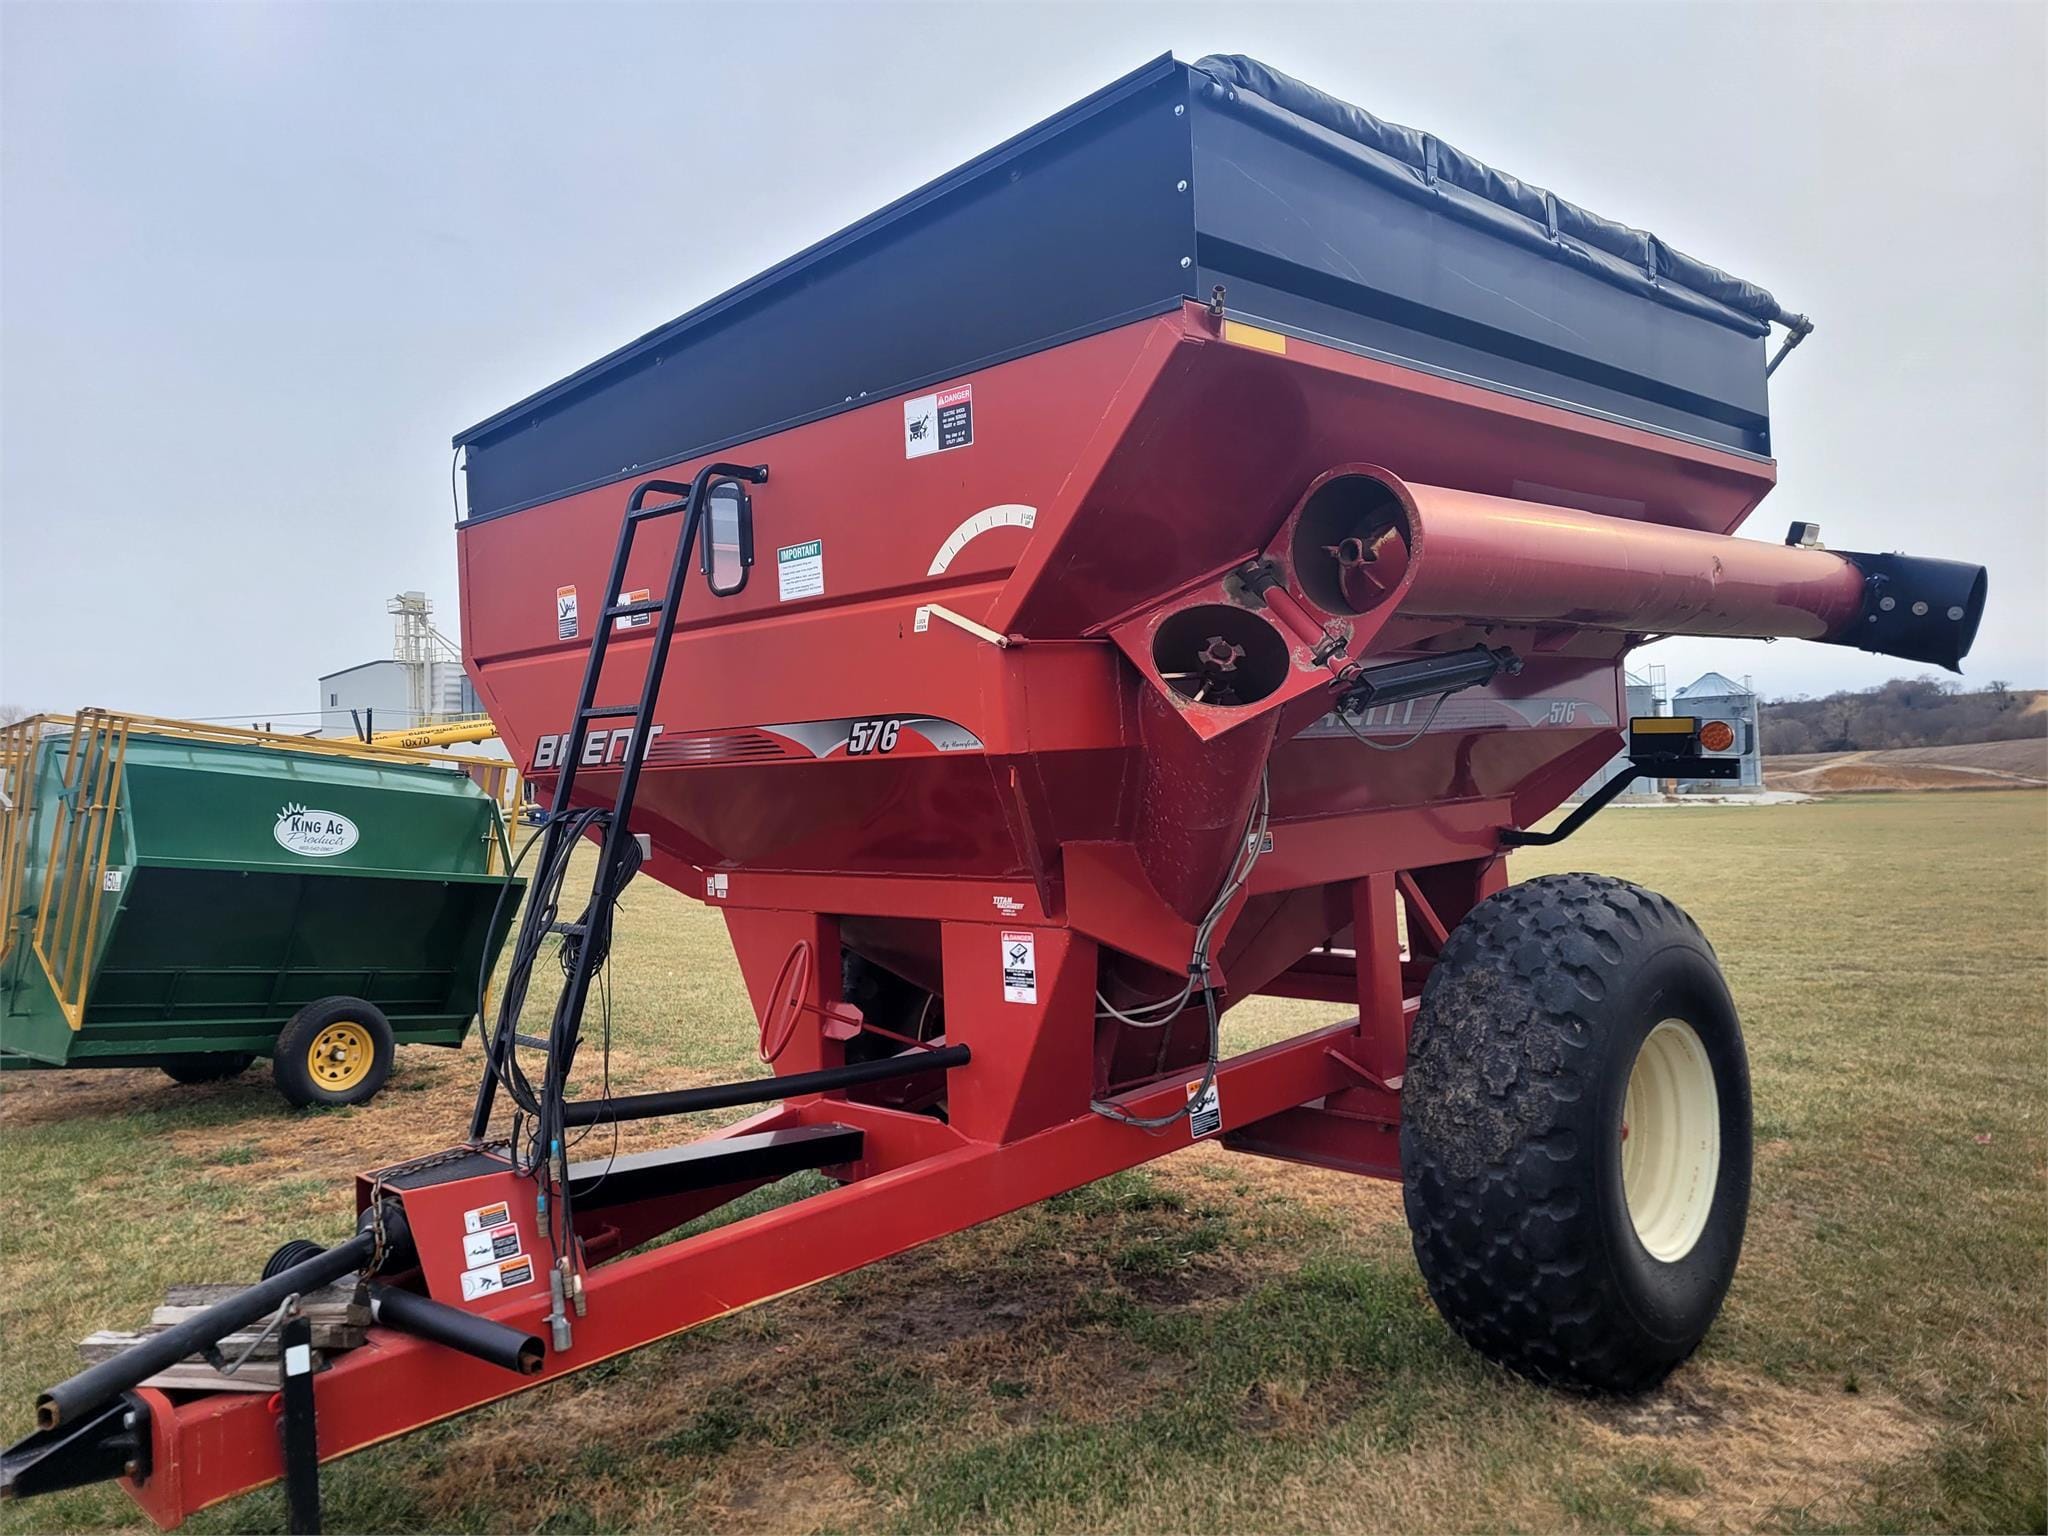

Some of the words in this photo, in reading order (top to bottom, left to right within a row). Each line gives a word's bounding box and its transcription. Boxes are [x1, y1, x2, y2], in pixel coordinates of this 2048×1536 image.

[944, 389, 970, 404] DANGER
[780, 543, 818, 561] IMPORTANT
[1550, 702, 1575, 723] 576
[401, 736, 430, 748] 10x70
[848, 719, 900, 753] 576
[286, 831, 345, 846] Products
